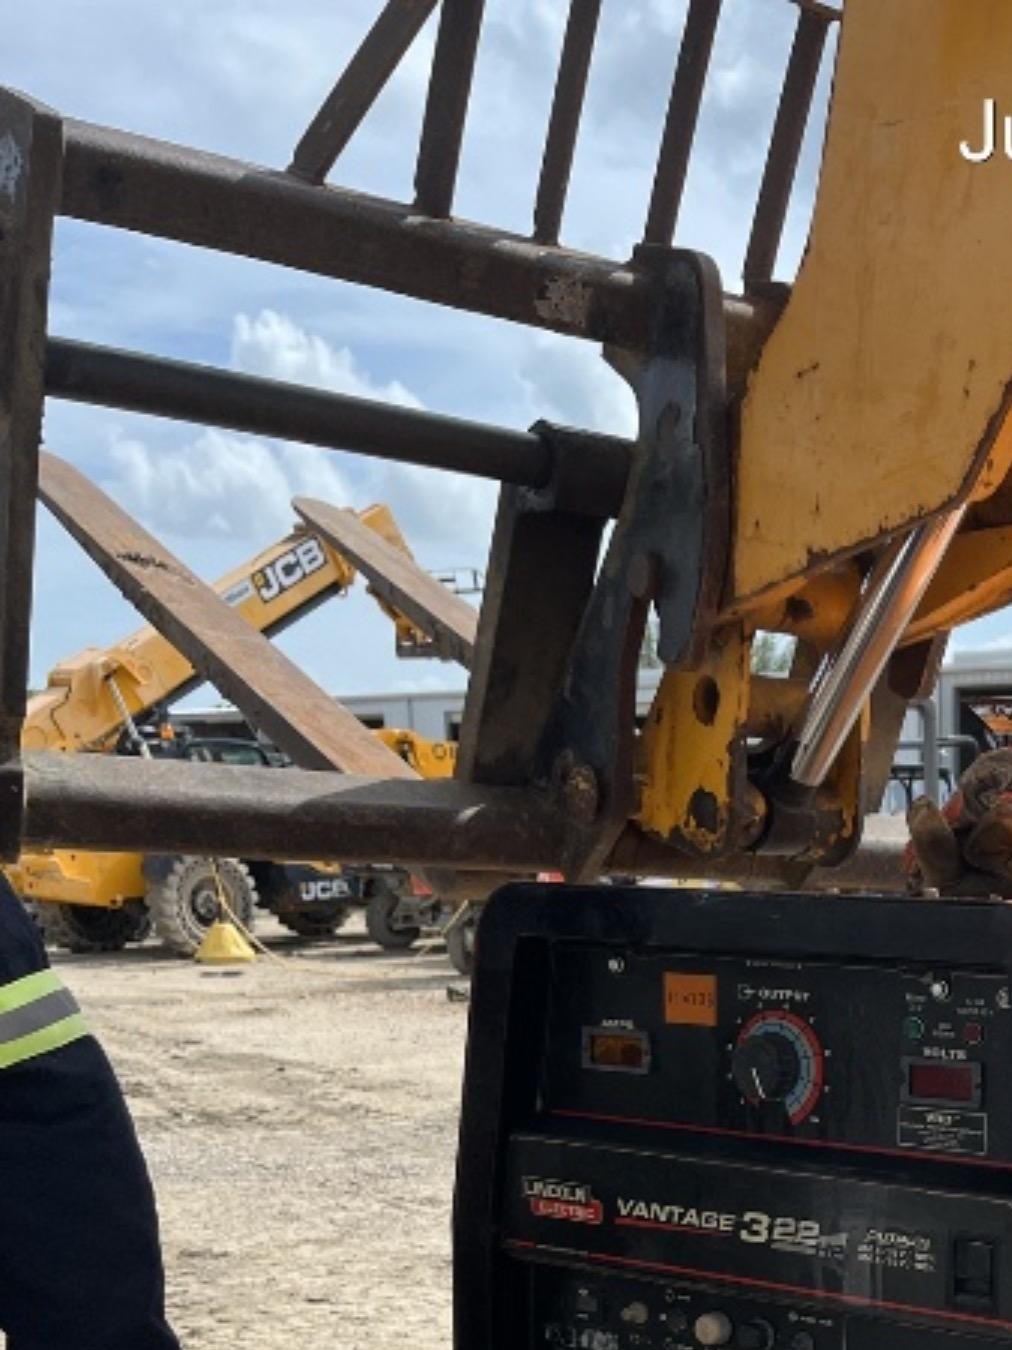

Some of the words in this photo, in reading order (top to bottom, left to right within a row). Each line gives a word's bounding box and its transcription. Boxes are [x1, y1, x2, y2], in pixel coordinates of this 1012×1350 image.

[260, 539, 325, 601] JCB
[300, 880, 351, 900] JCB
[617, 1197, 736, 1232] VANTAGE
[740, 1211, 821, 1246] 322
